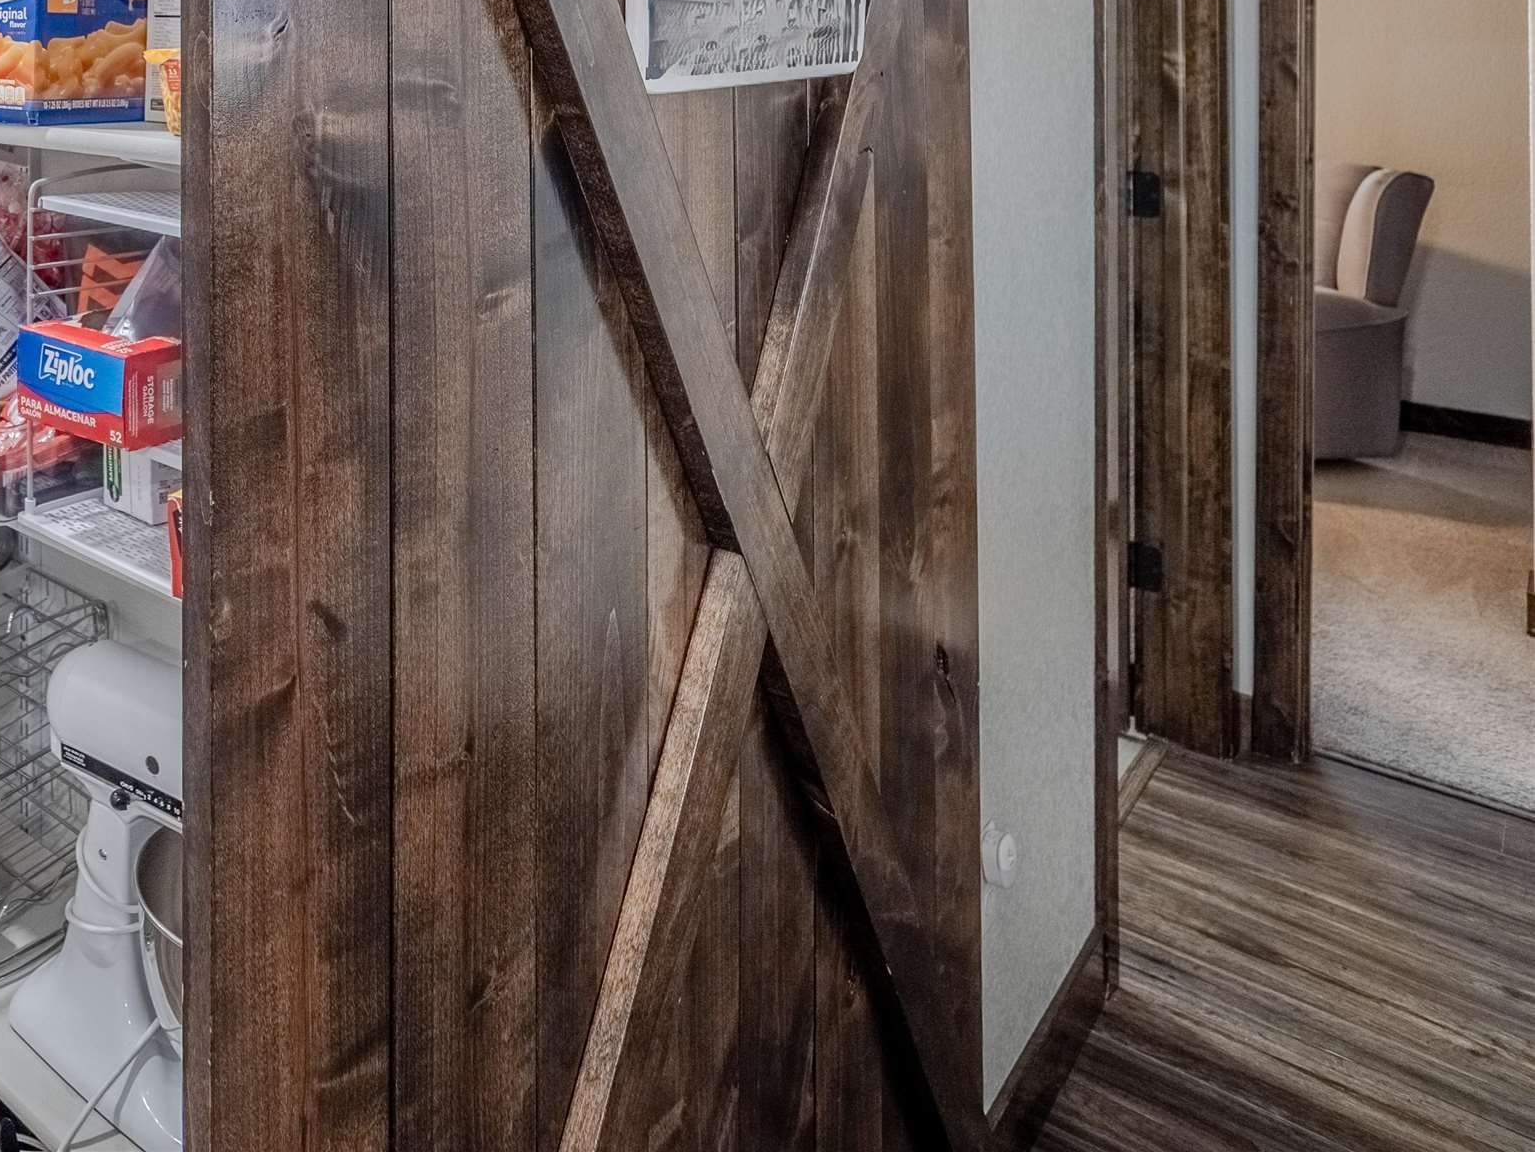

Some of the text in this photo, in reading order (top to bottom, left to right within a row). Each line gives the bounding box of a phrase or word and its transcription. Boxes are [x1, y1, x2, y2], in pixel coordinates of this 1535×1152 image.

[10, 21, 27, 29] flavor
[43, 350, 95, 389] Ziploc
[20, 396, 97, 428] PARA ALMACENAR
[109, 430, 122, 444] 52
